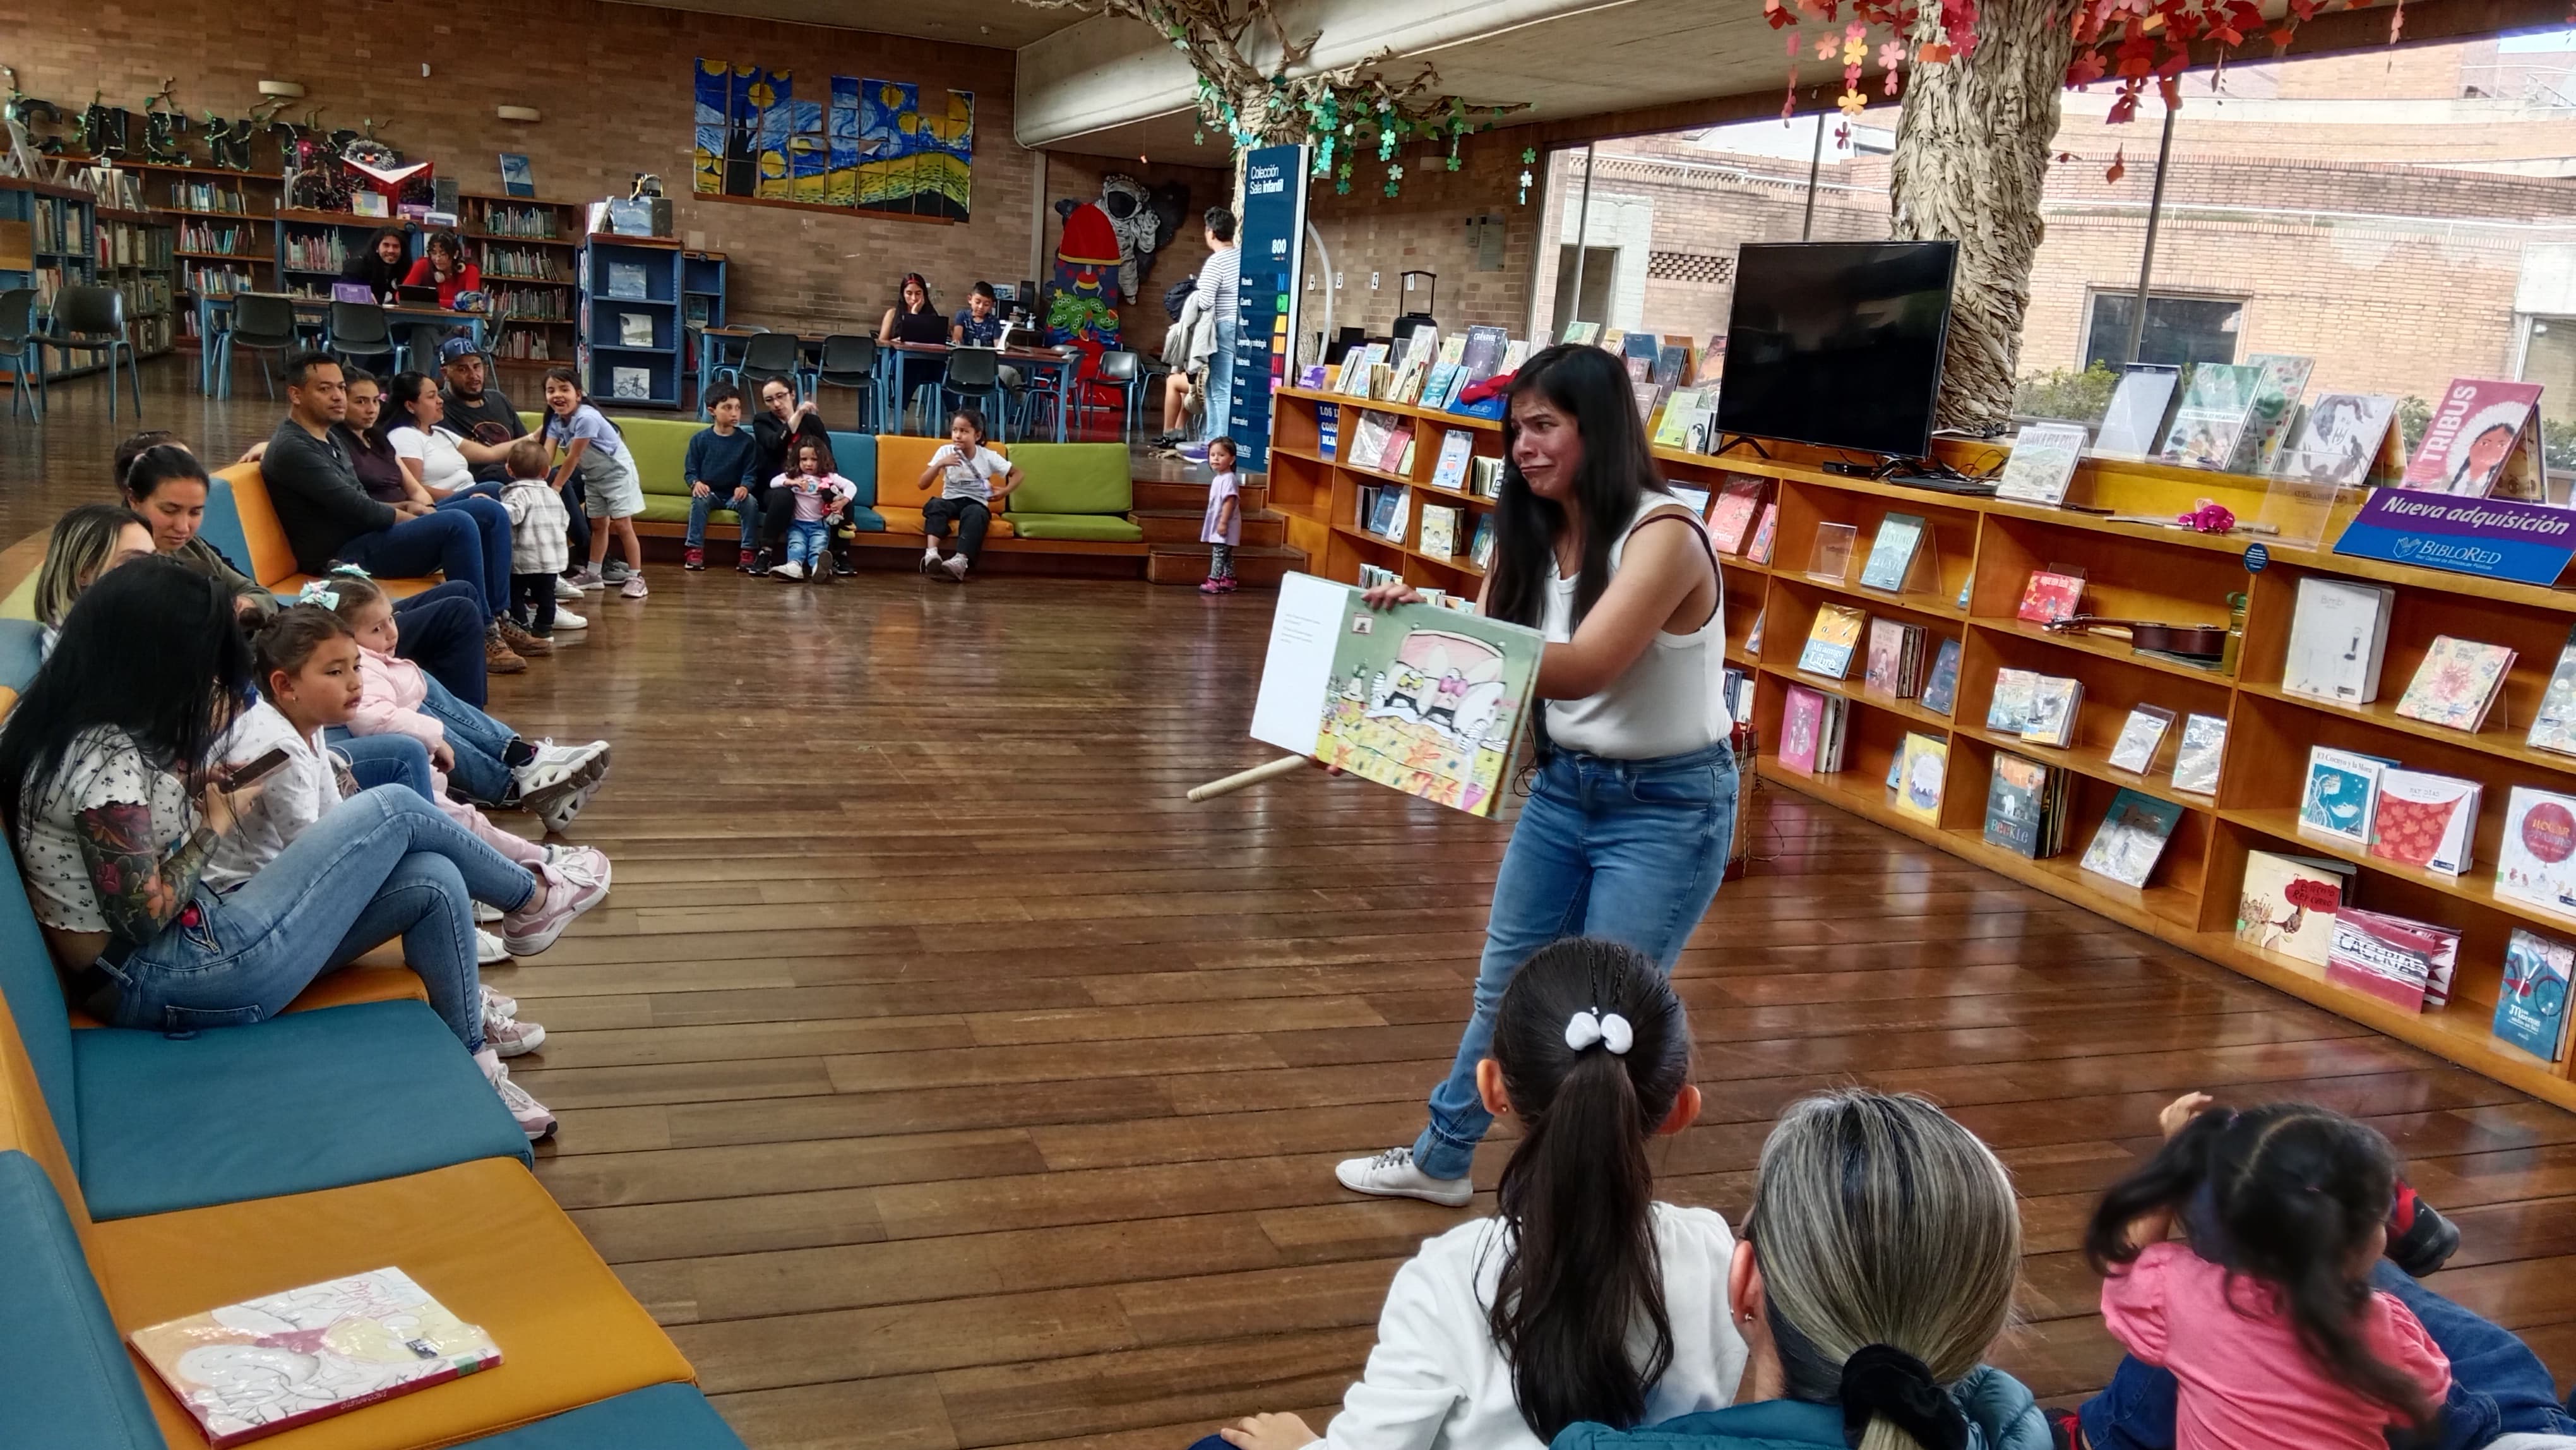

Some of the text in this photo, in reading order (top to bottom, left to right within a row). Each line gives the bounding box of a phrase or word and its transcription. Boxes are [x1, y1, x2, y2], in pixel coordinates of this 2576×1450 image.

[1251, 164, 1279, 179] Colección
[1249, 179, 1284, 195] Sala infantil
[1272, 239, 1287, 254] 800
[1278, 273, 1285, 291] N
[455, 341, 477, 354] 78
[1320, 406, 1339, 418] LOS L
[2418, 385, 2478, 462] TRIBUS
[2381, 496, 2570, 535] Nueva adquisición
[1812, 642, 1844, 657] Mi amigo
[1810, 651, 1836, 668] Libro
[2325, 753, 2347, 765] Cocuyo
[2532, 819, 2570, 837] HOGAR
[340, 1391, 388, 1410] INCOMPLETO
